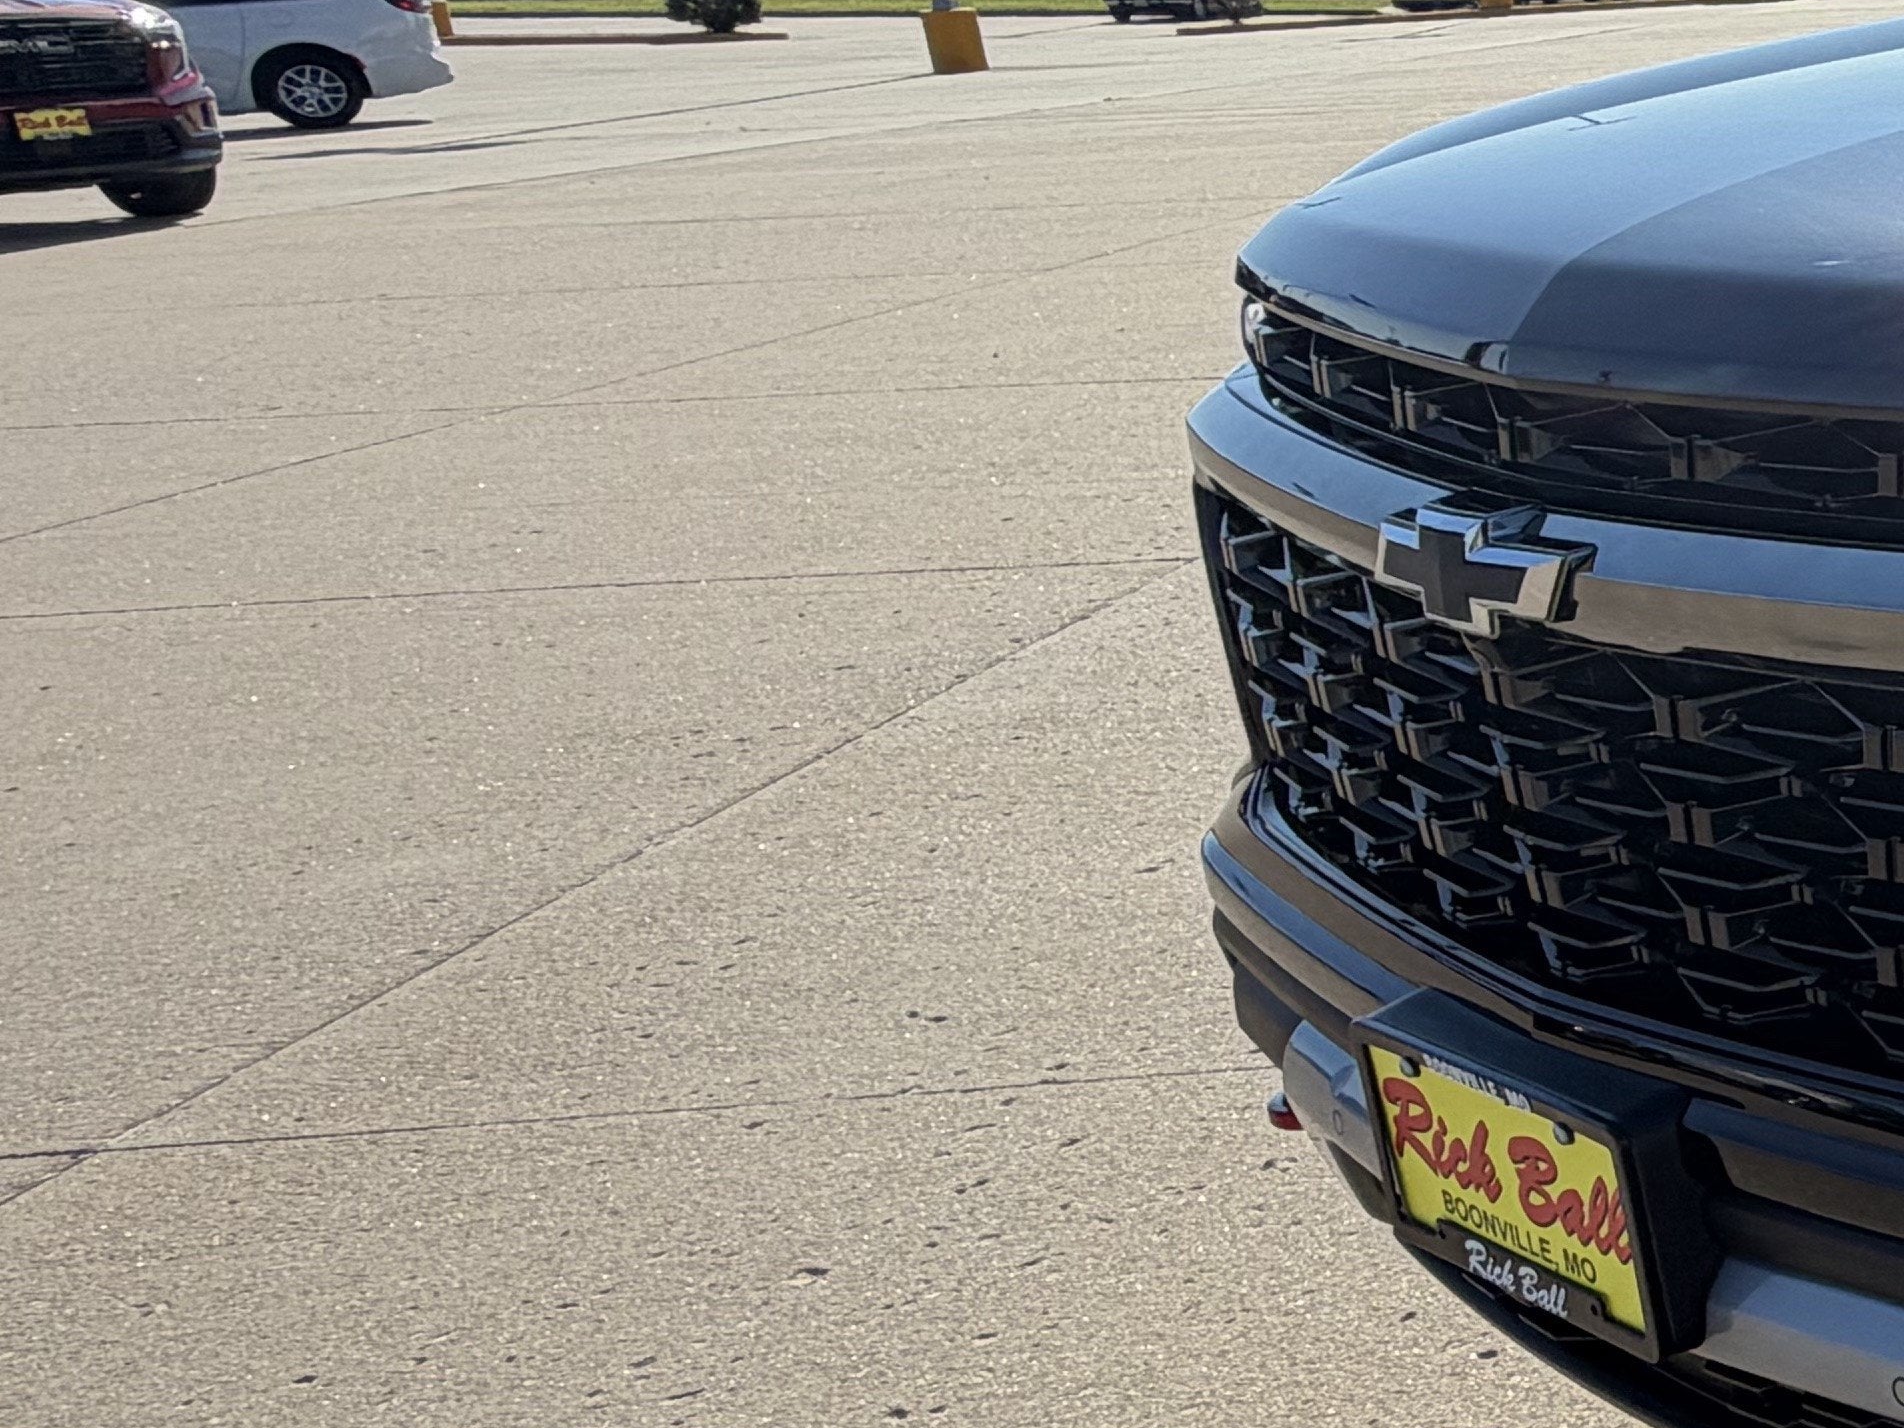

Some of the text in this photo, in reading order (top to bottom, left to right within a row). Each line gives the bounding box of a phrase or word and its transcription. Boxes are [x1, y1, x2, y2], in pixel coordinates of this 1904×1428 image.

[1382, 1077, 1633, 1264] Rick Ball
[1441, 1189, 1597, 1284] BOONVILLE, MO
[1464, 1239, 1568, 1317] Rick Ball
